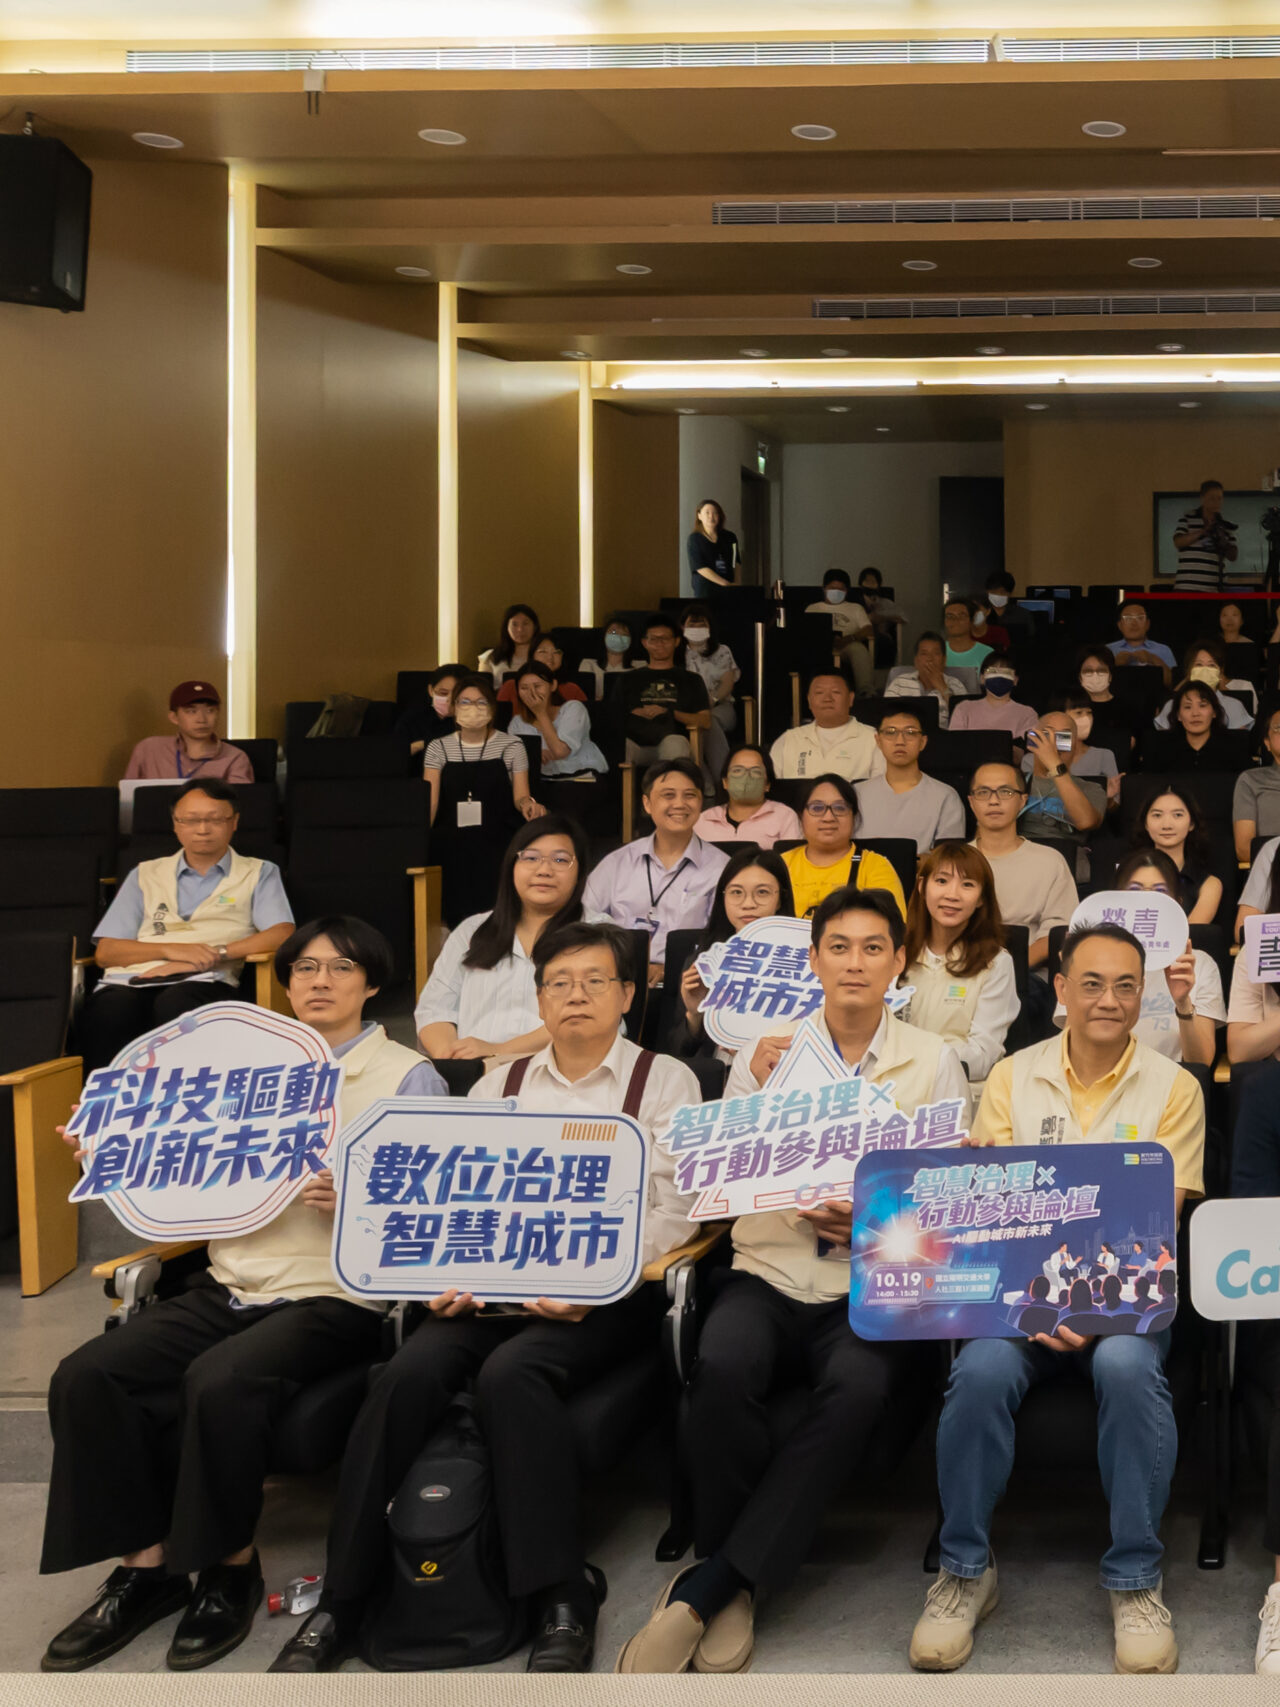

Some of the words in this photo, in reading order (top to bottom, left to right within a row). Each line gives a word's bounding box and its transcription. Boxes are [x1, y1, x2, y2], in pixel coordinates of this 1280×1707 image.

[718, 937, 820, 983] 智慧
[70, 1060, 338, 1137] 科技驅動
[78, 1119, 332, 1199] 創新未來
[365, 1142, 612, 1206] 數位治理
[677, 1099, 967, 1191] 行動參與論壇
[916, 1184, 1101, 1231] 行動參與論壇
[378, 1210, 625, 1271] 智慧城市
[875, 1271, 922, 1288] 10.19
